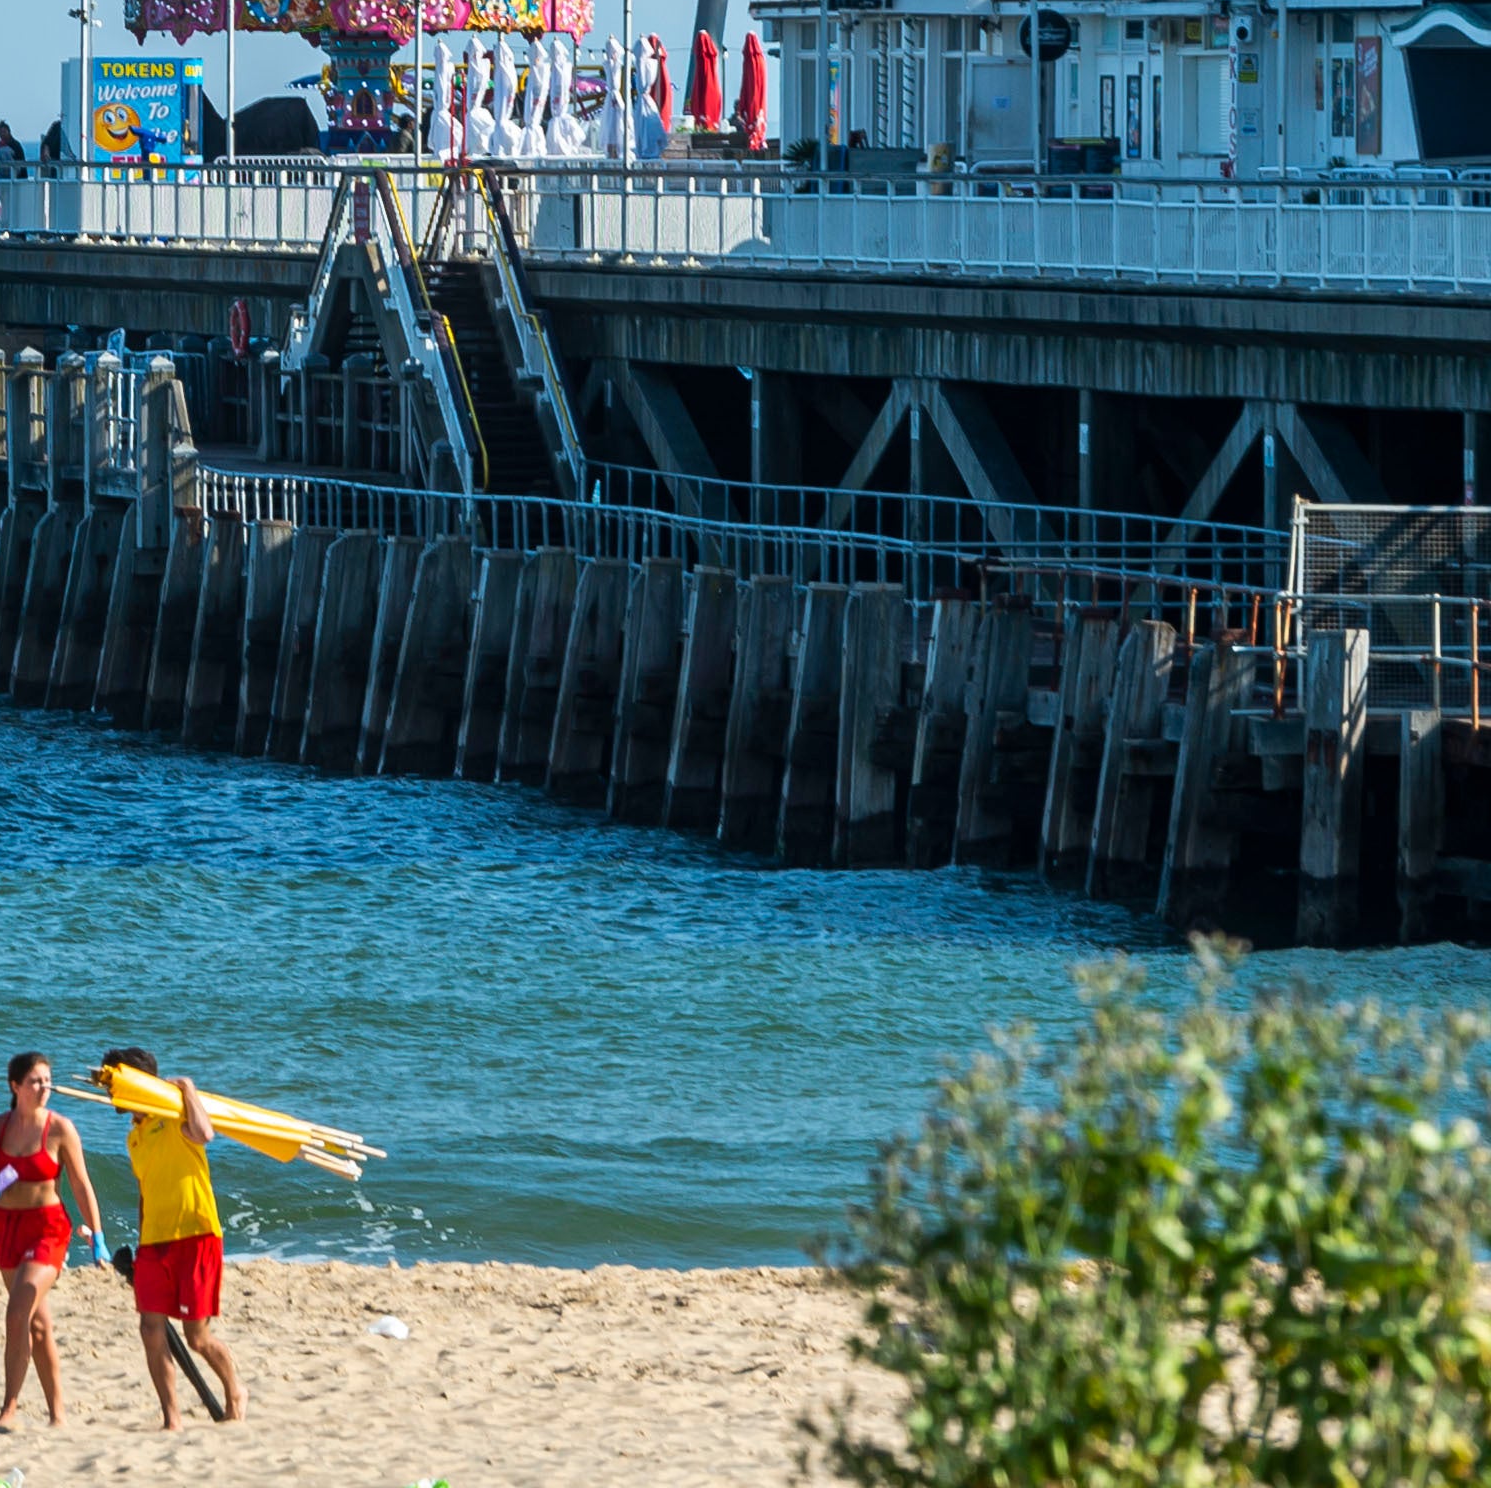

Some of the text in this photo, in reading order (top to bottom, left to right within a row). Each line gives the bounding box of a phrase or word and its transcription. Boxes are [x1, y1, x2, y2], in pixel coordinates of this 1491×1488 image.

[100, 63, 175, 78] TOKENS
[98, 83, 178, 101] Welcome
[148, 102, 169, 120] To
[1229, 56, 1237, 179] KIOSK
